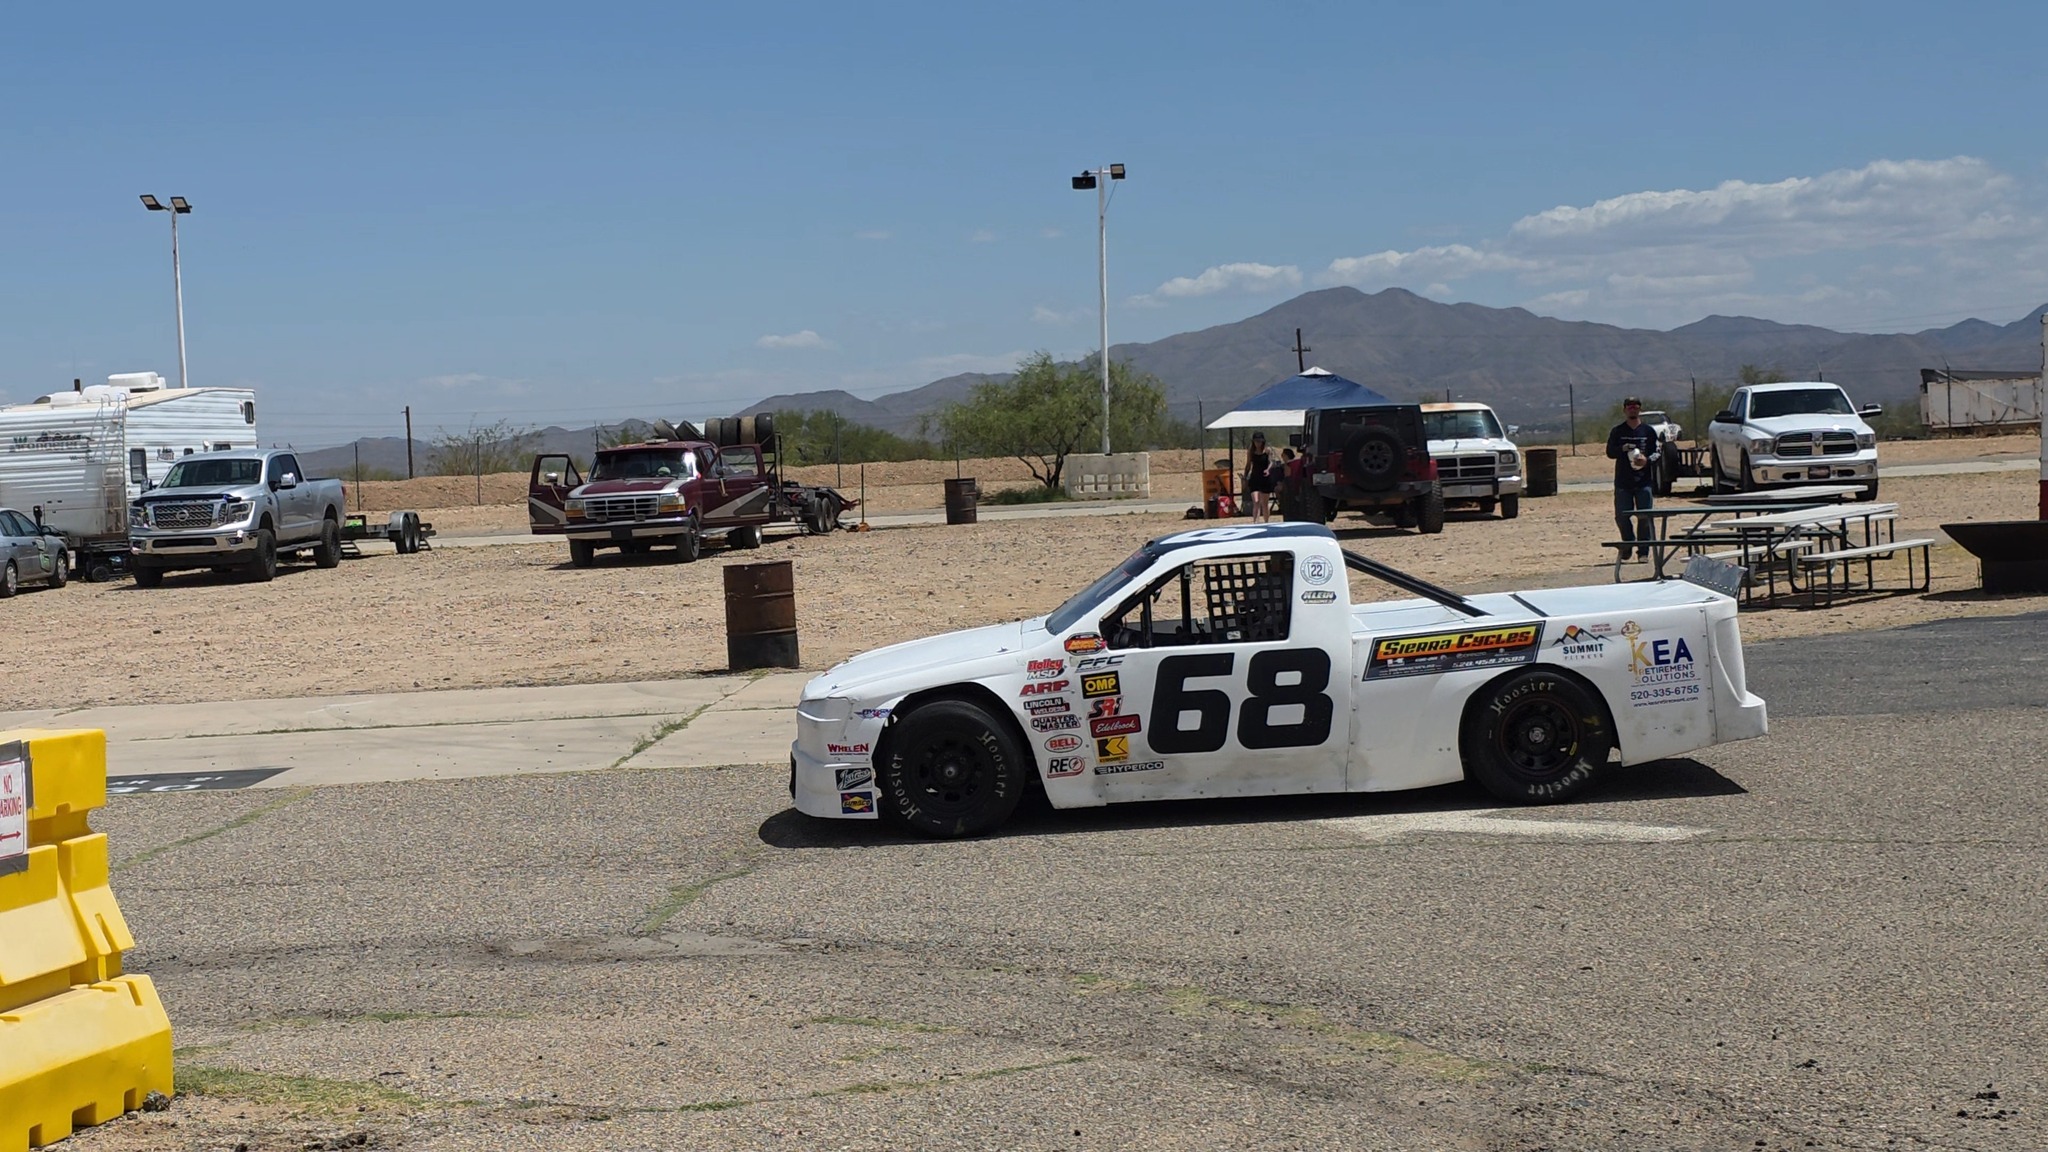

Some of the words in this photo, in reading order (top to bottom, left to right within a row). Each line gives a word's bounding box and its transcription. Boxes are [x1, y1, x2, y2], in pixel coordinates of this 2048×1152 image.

[1311, 564, 1323, 577] 22
[1562, 643, 1604, 655] SUMMIT
[1631, 637, 1694, 667] KEA
[1027, 659, 1064, 672] Holley
[1077, 655, 1126, 669] PFC
[1027, 669, 1060, 681] MSD
[1638, 663, 1695, 676] RETIREMENT
[1635, 671, 1696, 684] SOLUTIONS
[1019, 680, 1070, 697] ARP
[1085, 677, 1117, 692] OMP
[1490, 678, 1555, 716] Hoosier
[1630, 684, 1700, 701] 520-335-6755
[1025, 698, 1062, 709] LINCOLN
[1147, 647, 1334, 755] 68
[1033, 705, 1066, 715] WELDERS
[1032, 715, 1076, 728] QUARTER
[1040, 721, 1080, 731] MASTER
[1095, 720, 1137, 733] Edelbrock
[827, 743, 869, 753] WHELEN
[1050, 736, 1078, 749] BELL
[976, 730, 1008, 798] Hoosier
[1107, 761, 1164, 773] HYPERCO
[4, 774, 13, 794] NO
[1528, 757, 1593, 798] Hoosier
[888, 753, 922, 820] Hoosier
